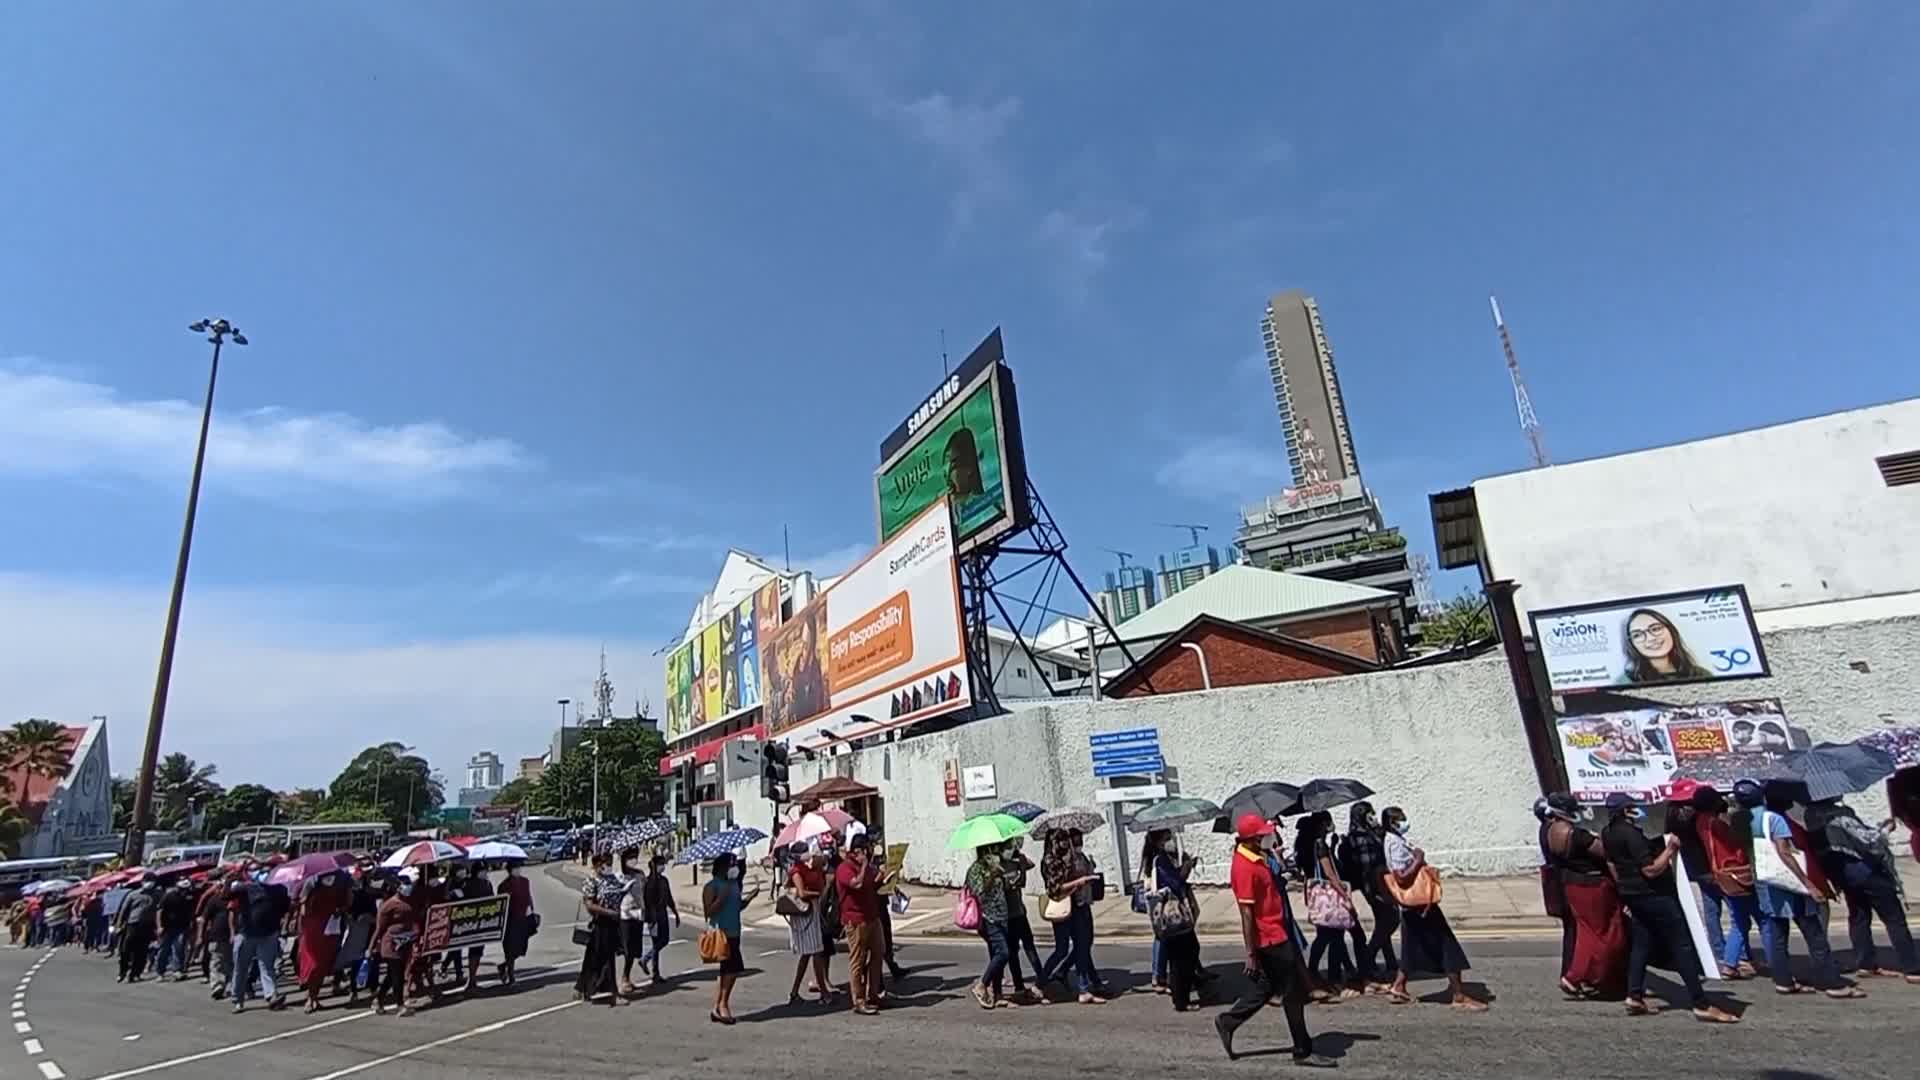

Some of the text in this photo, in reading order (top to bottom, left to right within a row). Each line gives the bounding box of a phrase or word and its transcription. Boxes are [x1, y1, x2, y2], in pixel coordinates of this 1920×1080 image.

[907, 375, 960, 436] SAMSUNG
[831, 638, 849, 660] Enjoy
[850, 604, 903, 648] Responsibility
[1552, 623, 1598, 638] VISION
[1710, 648, 1751, 672] 30
[1577, 767, 1637, 778] SunLeaf
